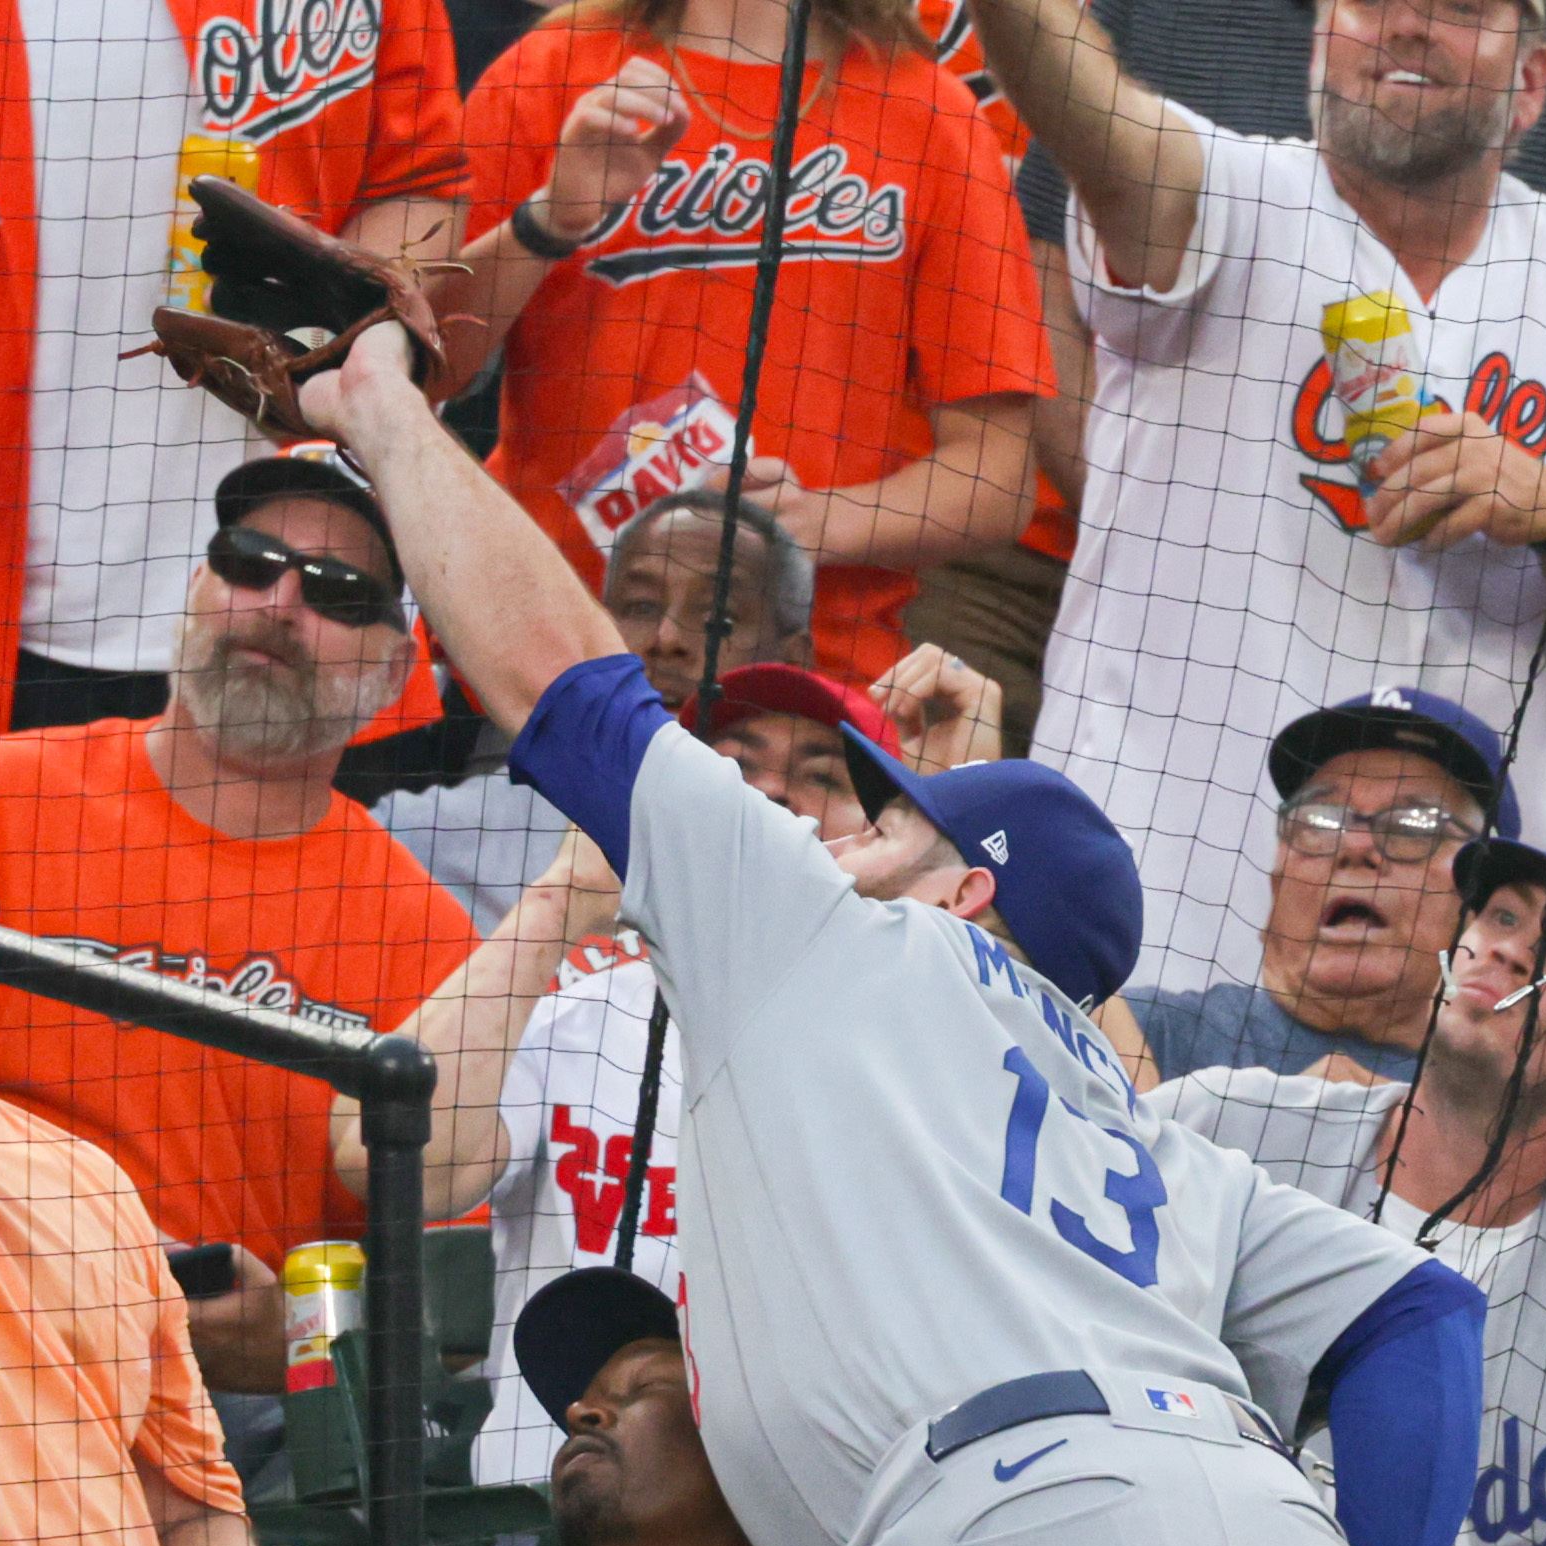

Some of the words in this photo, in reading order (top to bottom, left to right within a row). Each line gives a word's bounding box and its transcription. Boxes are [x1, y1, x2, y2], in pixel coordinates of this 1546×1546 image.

[594, 416, 726, 532] DAVID
[965, 923, 1136, 1122] MNCY
[1000, 1044, 1168, 1289] 13
